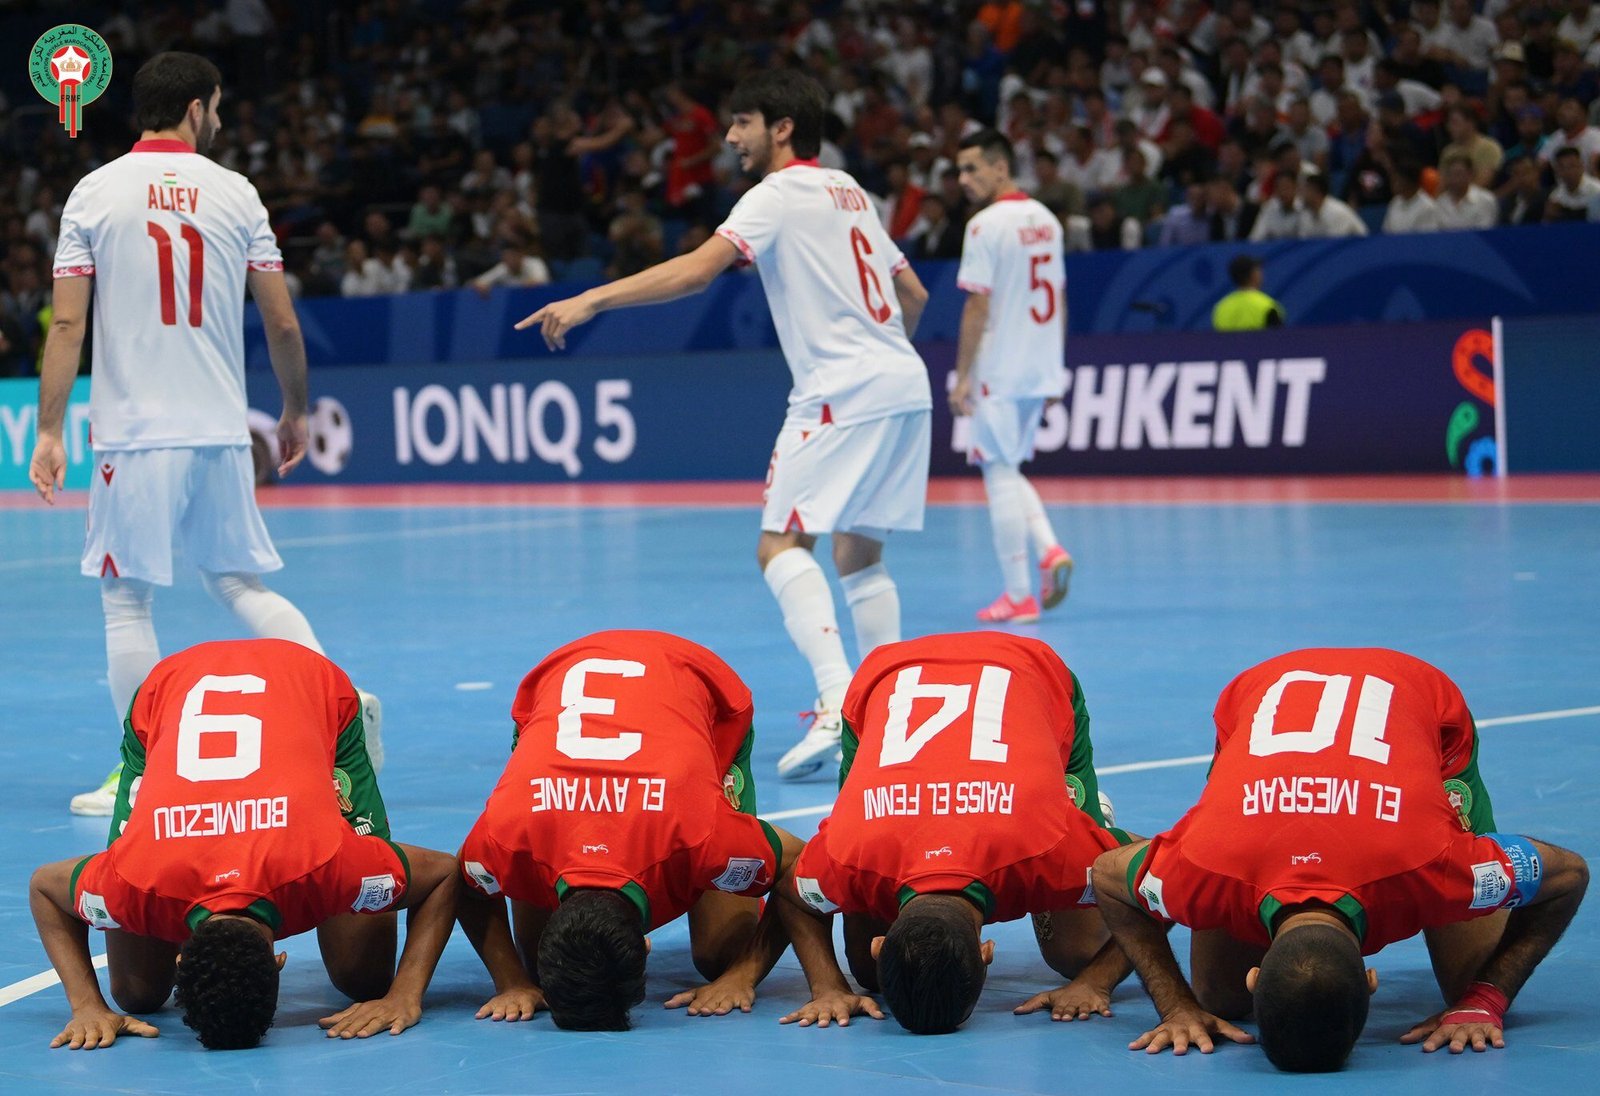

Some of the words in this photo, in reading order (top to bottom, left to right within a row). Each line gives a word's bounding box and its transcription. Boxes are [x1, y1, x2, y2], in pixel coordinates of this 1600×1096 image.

[147, 183, 199, 214] ALIEV
[147, 221, 204, 328] 11
[850, 226, 892, 324] 6
[1030, 253, 1056, 325] 5
[393, 380, 582, 478] IONIQ
[593, 379, 637, 463] 5
[176, 674, 267, 783] 9
[556, 658, 646, 761] 3
[879, 665, 1012, 768] 14
[1249, 670, 1395, 765] 10
[530, 777, 630, 813] AYYANE
[637, 778, 666, 812] EL
[863, 783, 921, 820] FENNI
[927, 782, 951, 815] EL
[956, 781, 1015, 815] RAISS
[1242, 776, 1360, 816] MESRAR
[1370, 782, 1402, 823] EL
[153, 796, 288, 841] BOUMEZOU
[1485, 872, 1494, 900] UNITES
